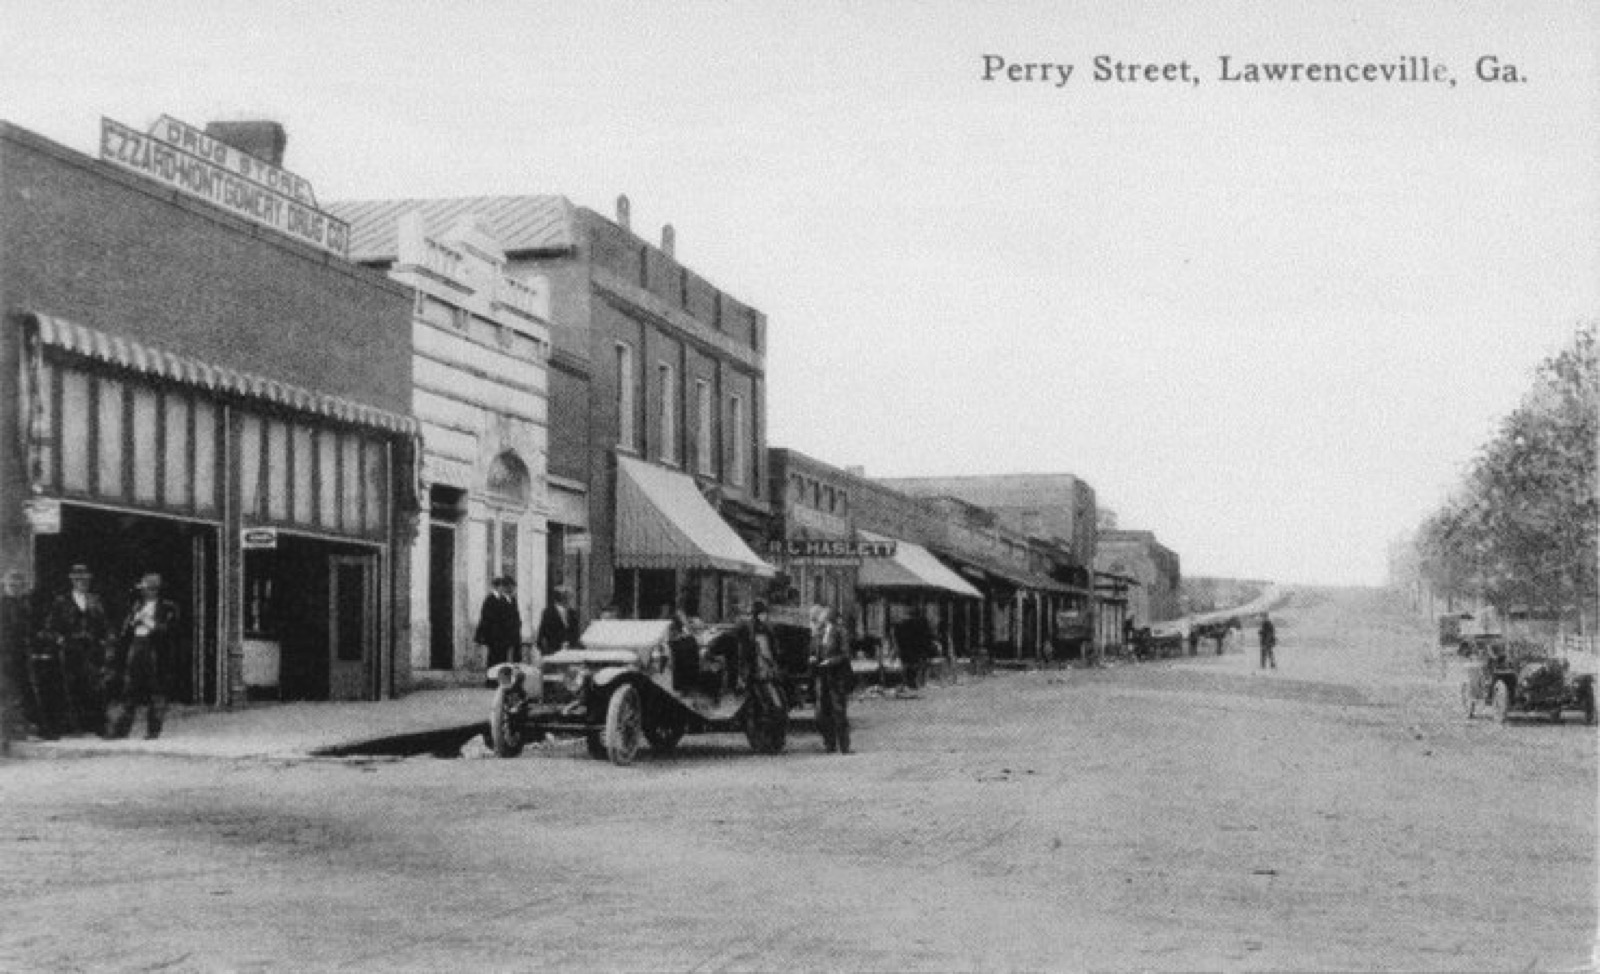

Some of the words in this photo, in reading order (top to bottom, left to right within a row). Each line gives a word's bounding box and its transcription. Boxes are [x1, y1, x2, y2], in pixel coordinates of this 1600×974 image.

[168, 123, 227, 162] DRUG
[241, 157, 309, 200] STORE
[288, 201, 322, 243] DRUG
[806, 540, 896, 556] HASLETT
